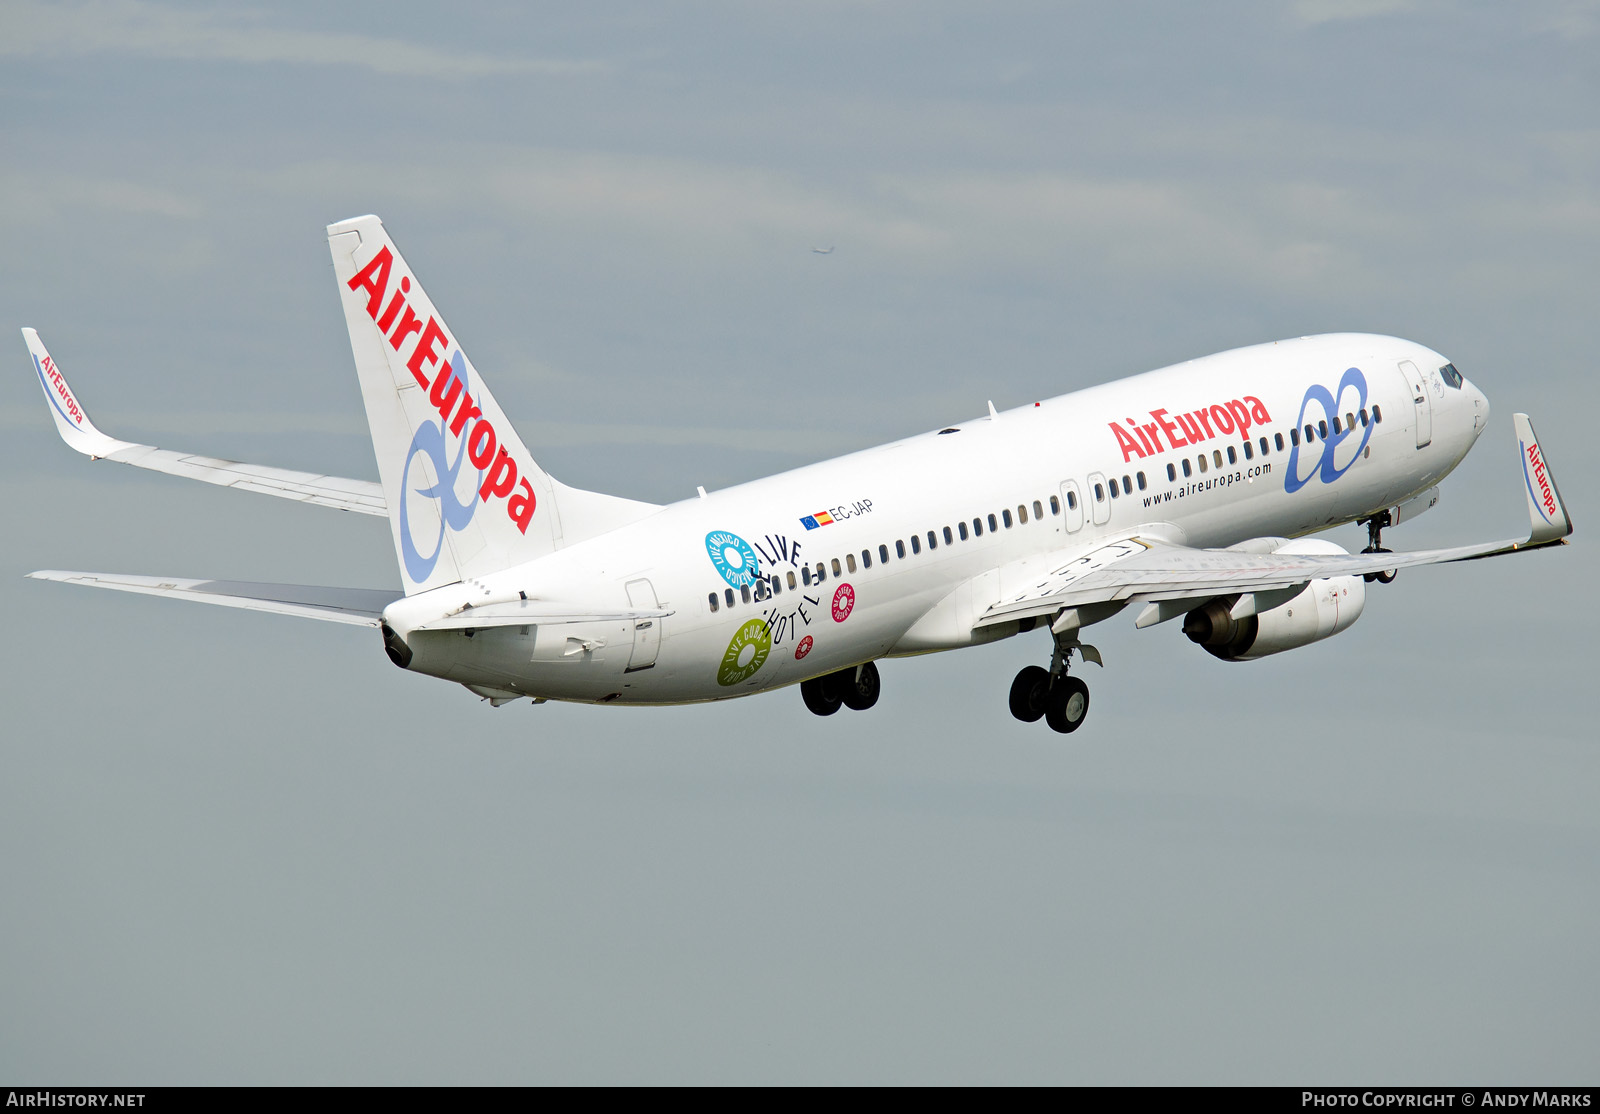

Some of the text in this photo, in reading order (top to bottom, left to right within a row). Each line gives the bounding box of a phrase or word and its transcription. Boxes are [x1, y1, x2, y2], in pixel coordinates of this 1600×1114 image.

[41, 356, 83, 424] AirEuropa
[347, 244, 537, 535] AirEuropa
[1108, 395, 1272, 463] AirEuropa
[1143, 461, 1272, 507] www.aireuropa.com
[1527, 443, 1556, 516] AirEuropa
[829, 499, 873, 522] EC-JAP
[1428, 497, 1437, 508] AP
[709, 533, 740, 565] LIVE MEXICO
[754, 534, 802, 569] LIVE
[726, 625, 764, 662] LIVE CUBA
[749, 648, 768, 673] LIVE
